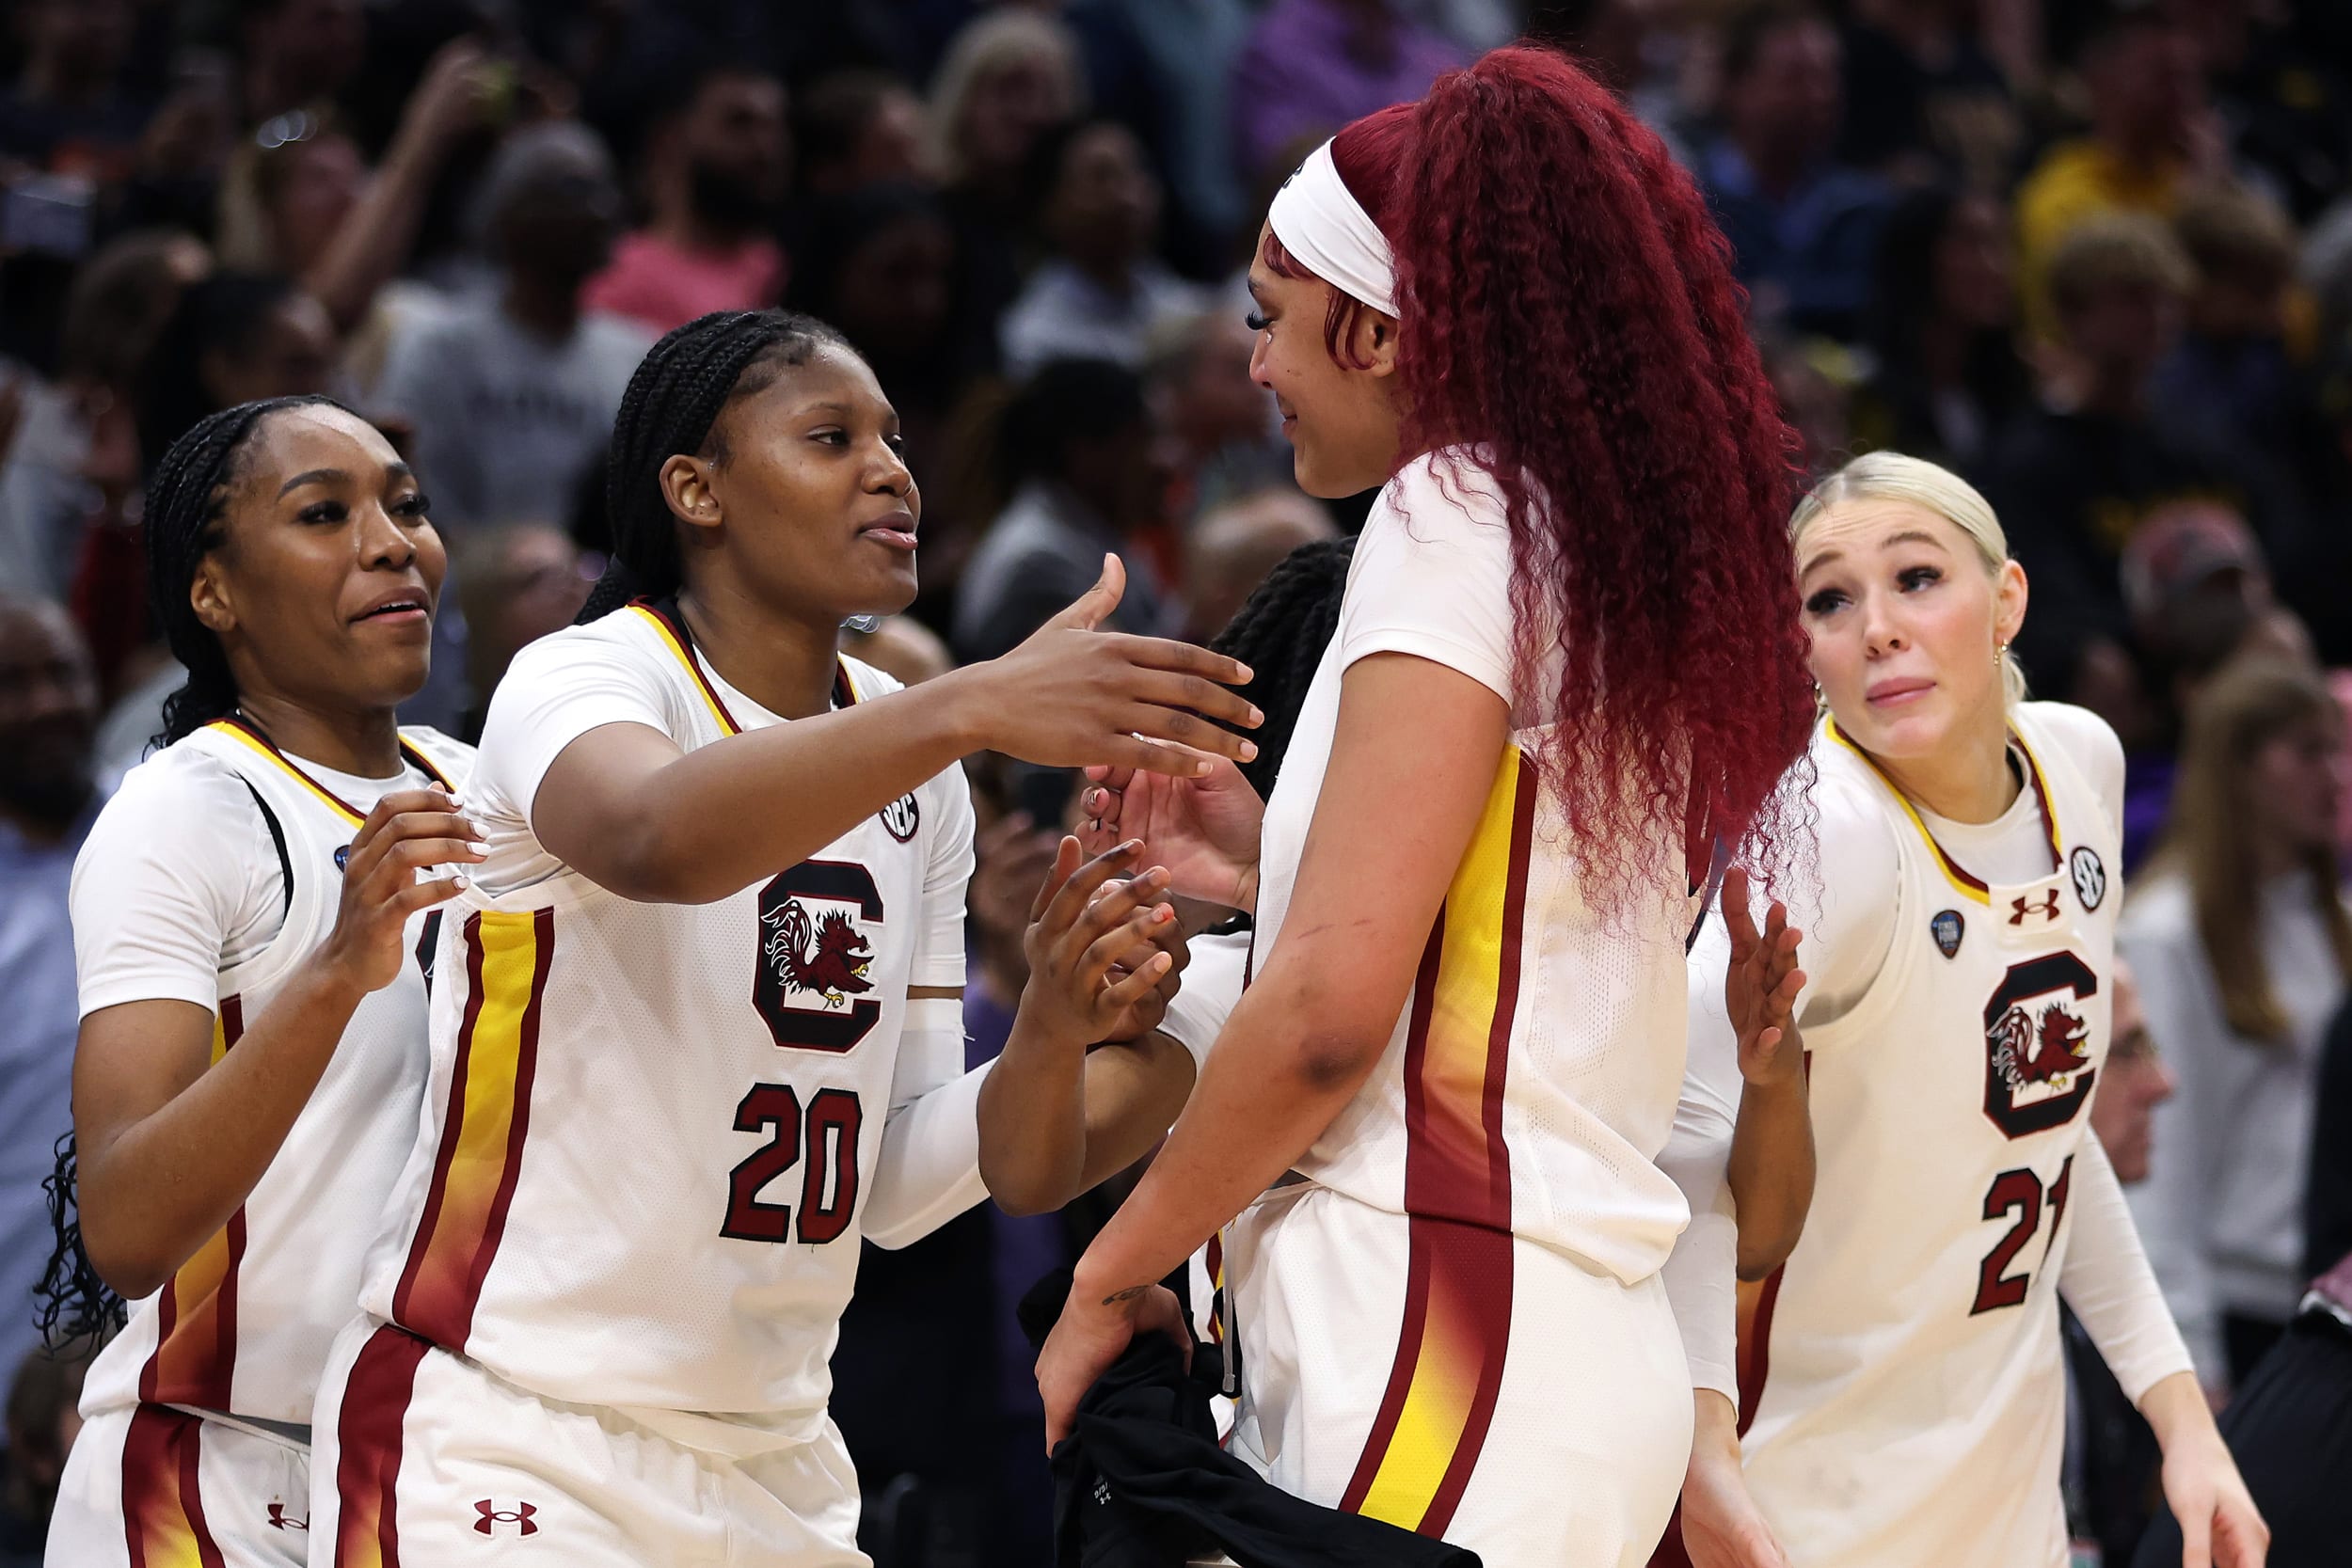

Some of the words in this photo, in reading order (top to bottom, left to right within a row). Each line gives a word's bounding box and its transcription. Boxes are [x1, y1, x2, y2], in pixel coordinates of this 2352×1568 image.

[753, 859, 884, 1053] C
[2073, 849, 2104, 909] SEC
[1983, 950, 2097, 1142] C
[719, 1083, 863, 1244] 20
[1968, 1152, 2075, 1317] 21
